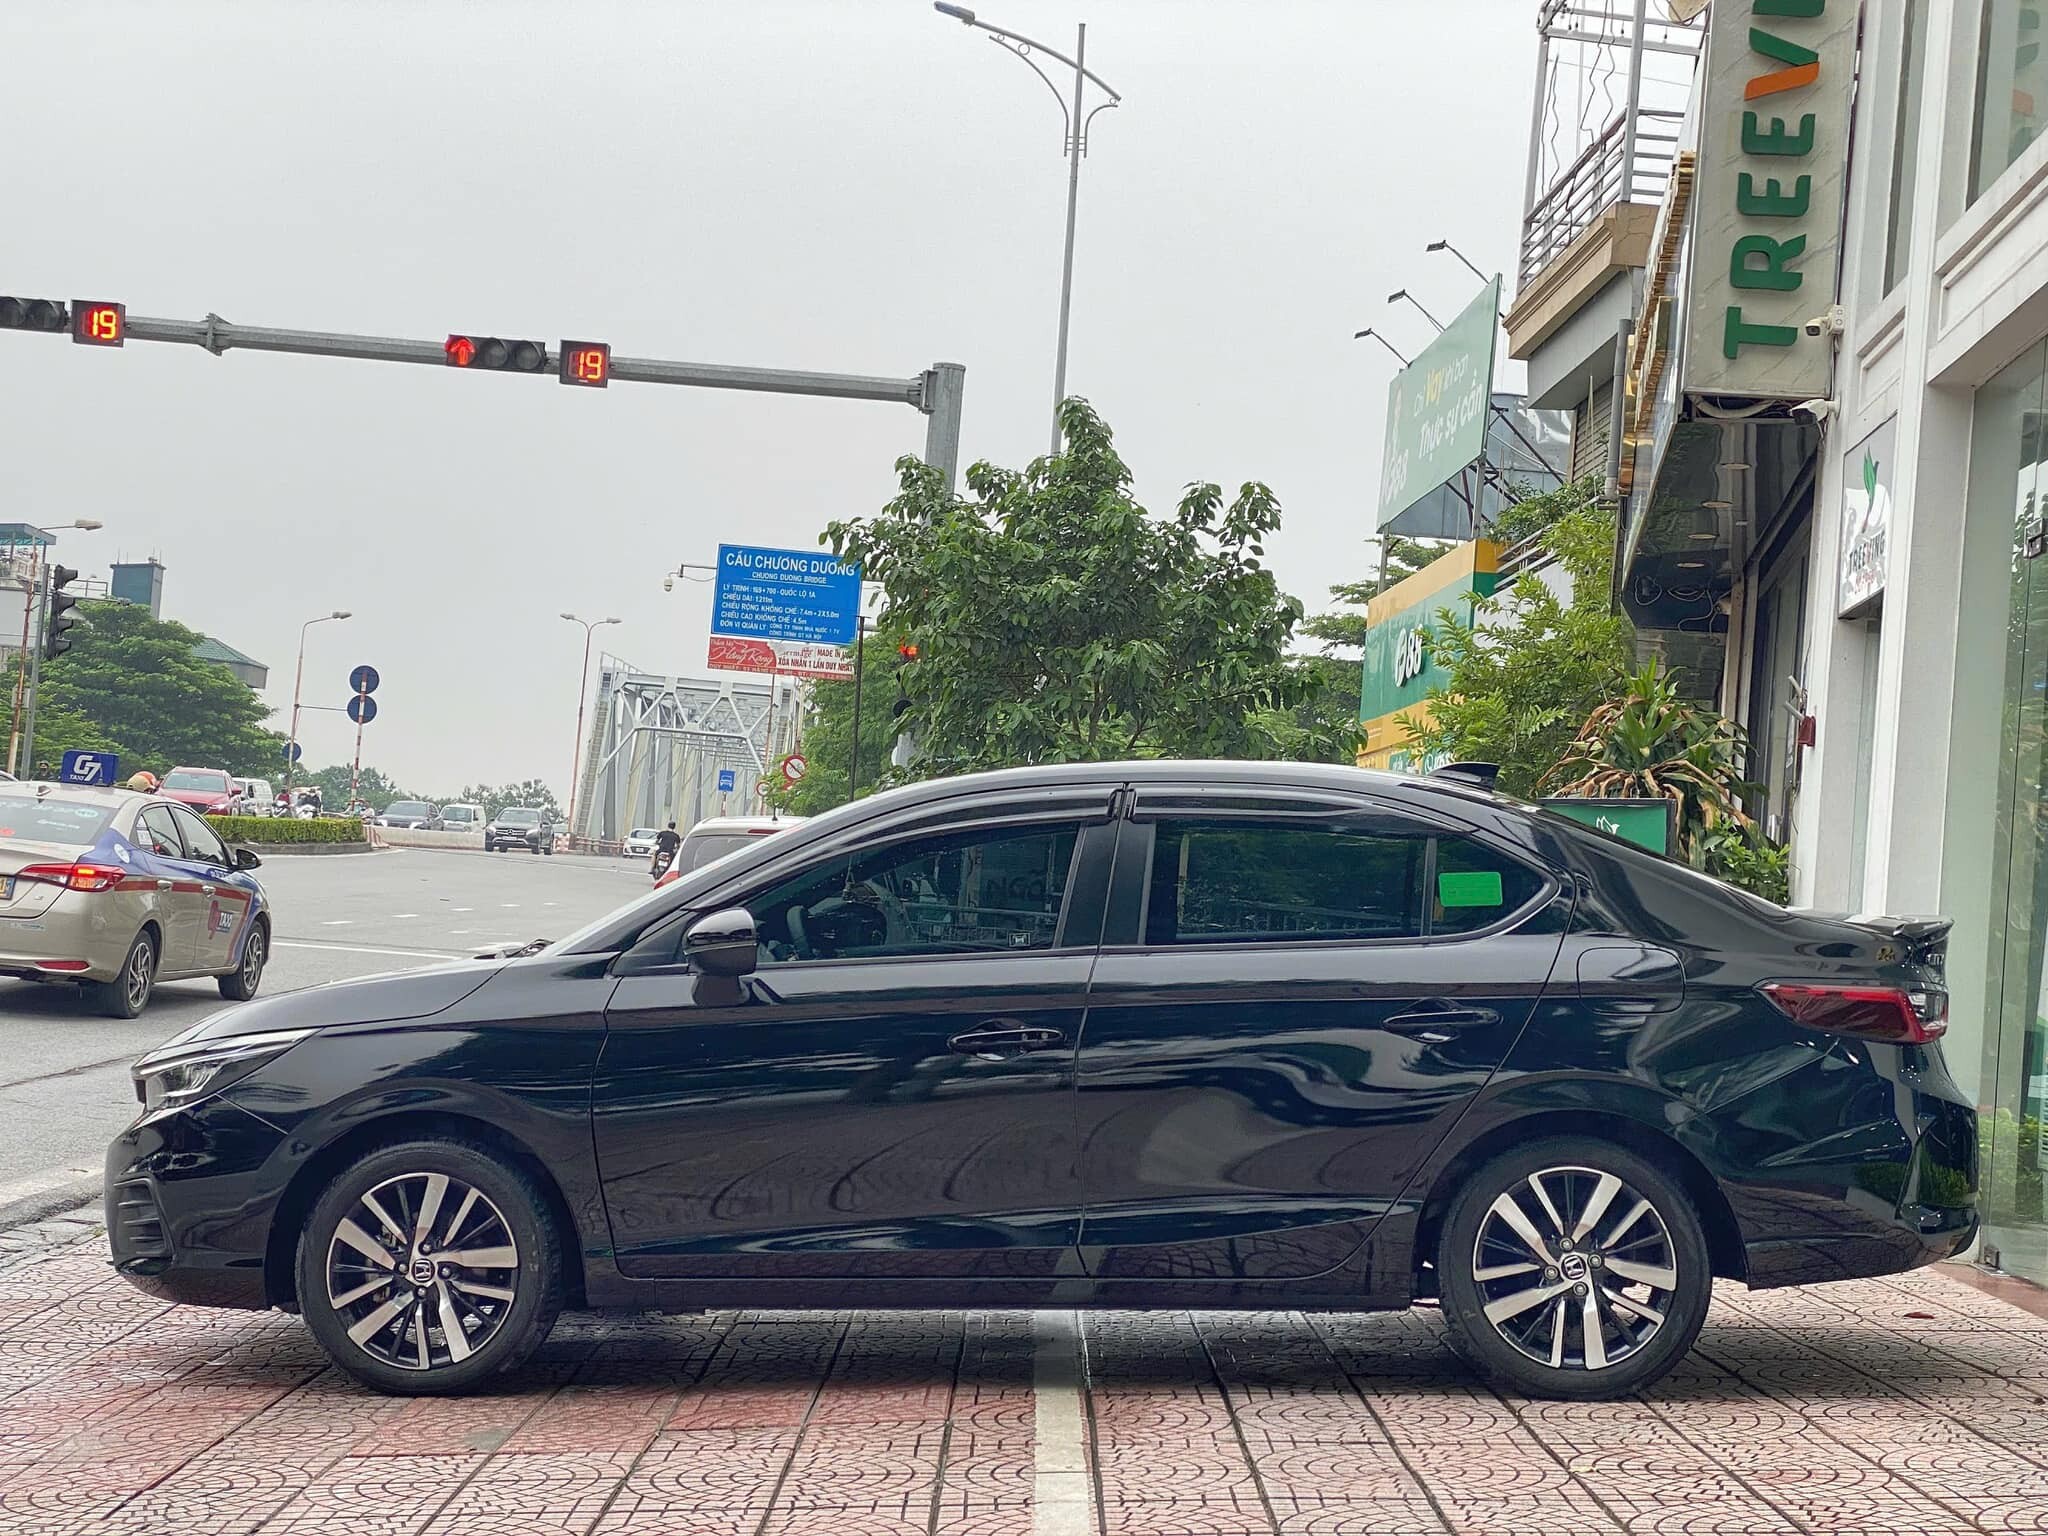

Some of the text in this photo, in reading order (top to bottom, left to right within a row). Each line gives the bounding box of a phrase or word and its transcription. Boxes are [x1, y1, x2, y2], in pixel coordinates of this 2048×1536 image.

[92, 310, 116, 339] 19
[579, 351, 602, 379] 19
[804, 576, 827, 585] BRIDGE
[817, 648, 833, 657] MADE
[74, 755, 101, 781] G7
